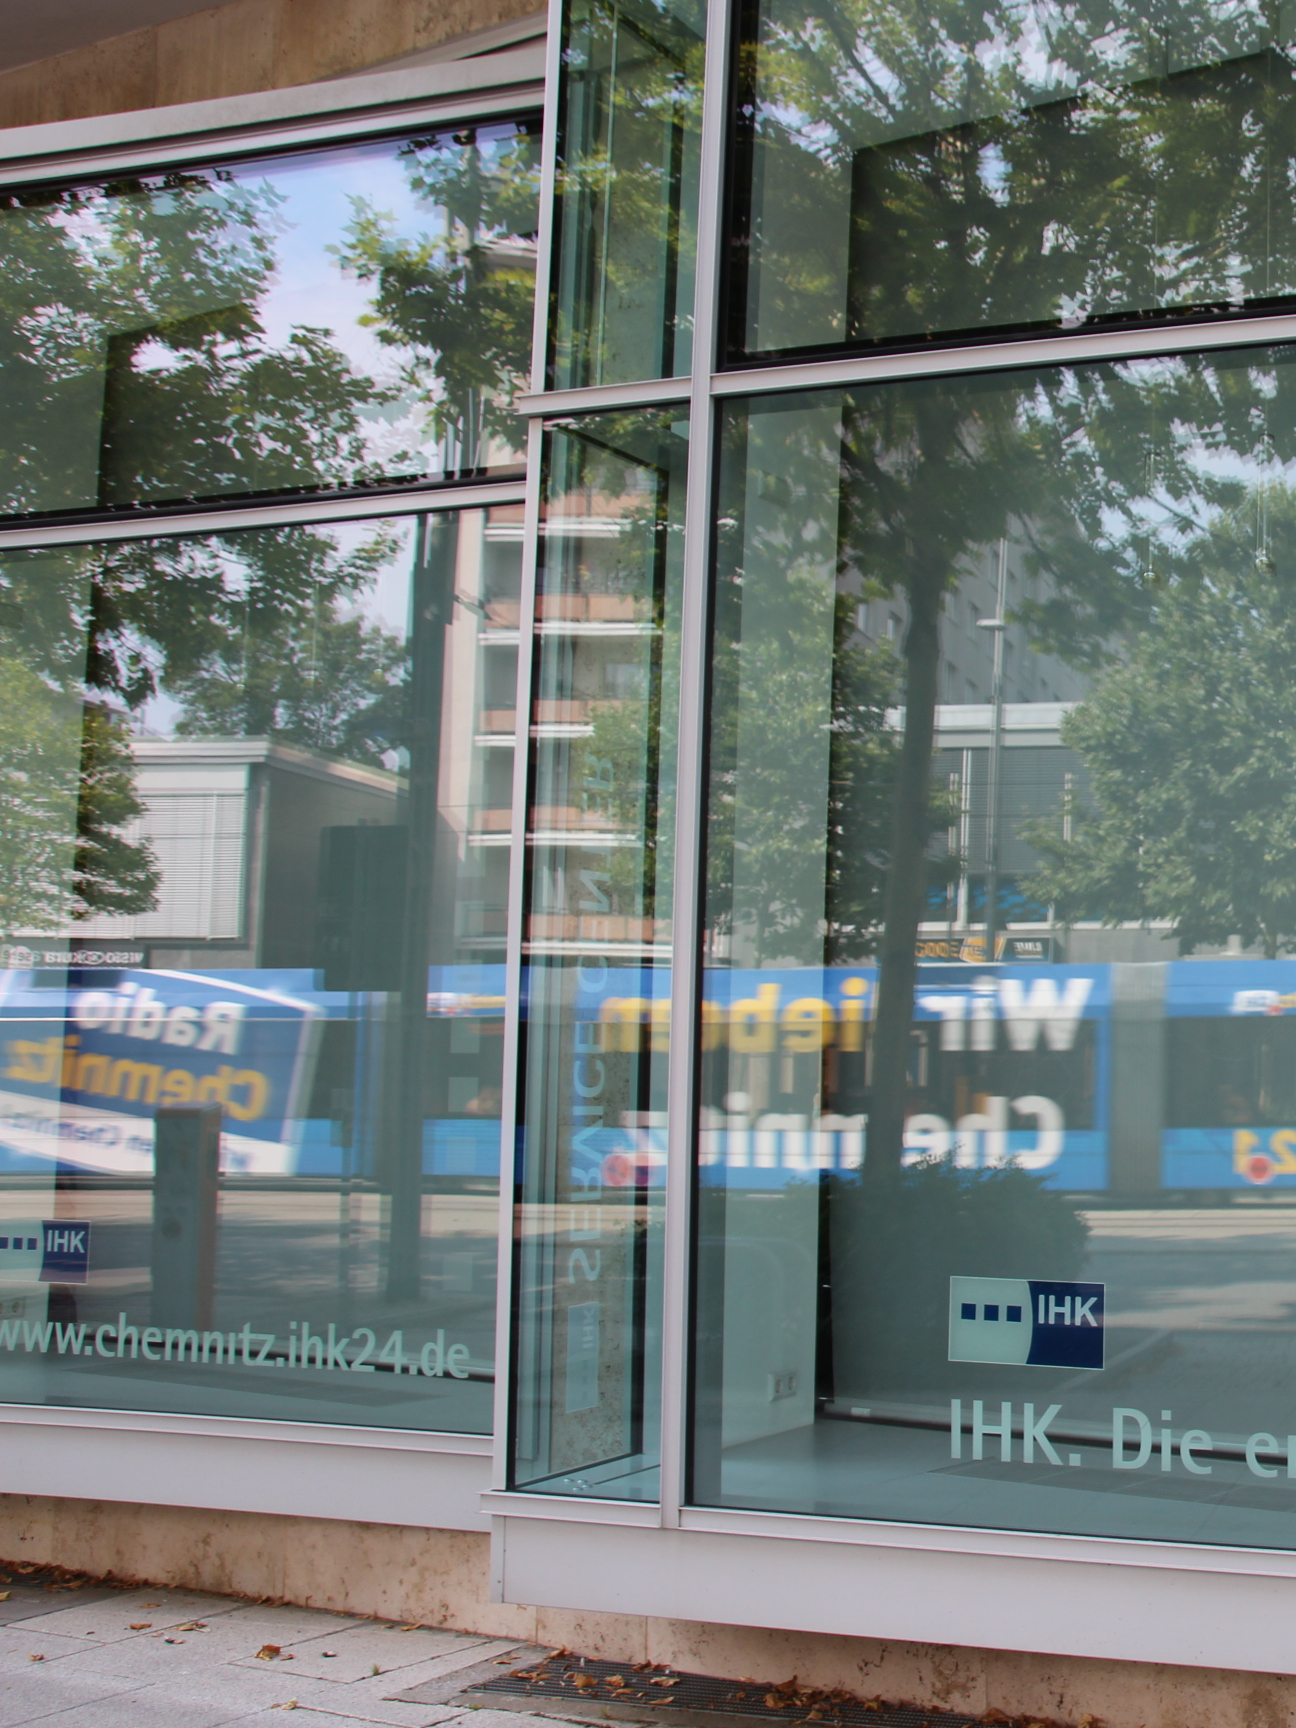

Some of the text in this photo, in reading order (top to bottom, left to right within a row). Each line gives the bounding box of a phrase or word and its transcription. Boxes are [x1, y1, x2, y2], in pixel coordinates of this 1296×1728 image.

[45, 1229, 86, 1253] IHK
[1037, 1294, 1099, 1328] IHK
[0, 1311, 470, 1379] www.chemnitz.ihk24.de
[949, 1398, 1080, 1467] IHK.
[1112, 1407, 1212, 1475] Die
